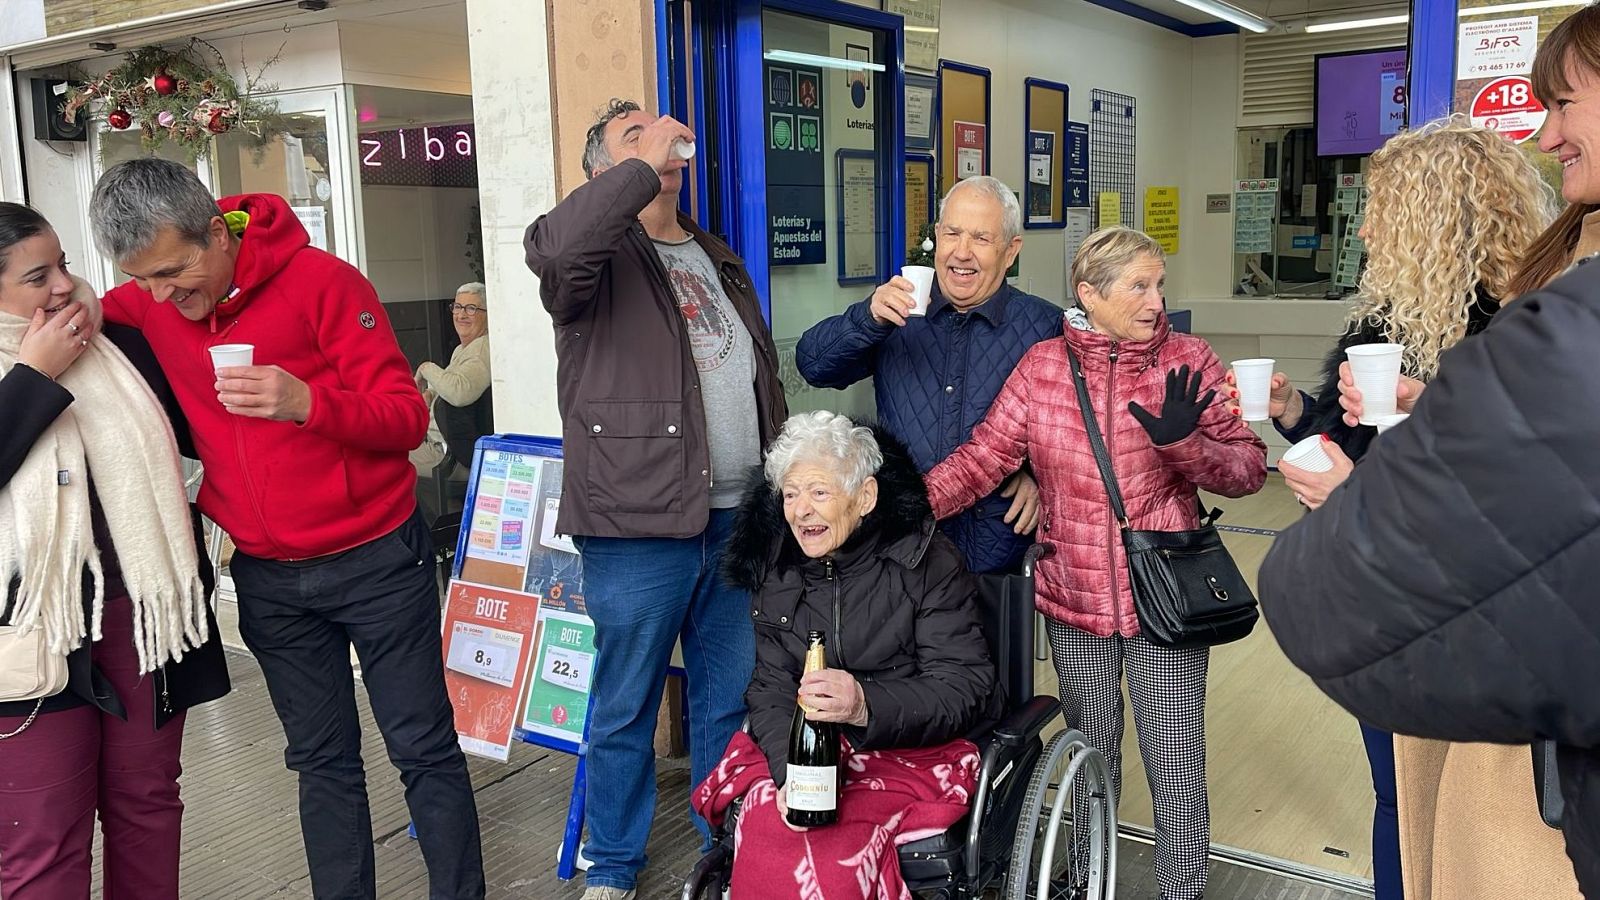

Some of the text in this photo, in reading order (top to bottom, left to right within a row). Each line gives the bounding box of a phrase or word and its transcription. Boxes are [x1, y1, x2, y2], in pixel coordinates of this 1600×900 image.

[1489, 63, 1503, 71] 465
[1506, 62, 1514, 70] 17
[1516, 61, 1526, 69] 69
[1487, 83, 1529, 107] +18
[964, 129, 976, 143] BOTE
[360, 127, 471, 167] ziba
[773, 214, 811, 230] Loterías y
[773, 230, 822, 245] Apuestas del
[773, 246, 801, 258] Estado
[498, 452, 524, 463] BOTES
[475, 596, 510, 621] BOTE
[560, 627, 583, 645] BOTE
[474, 650, 492, 666] 8,9
[552, 660, 579, 679] 22,5
